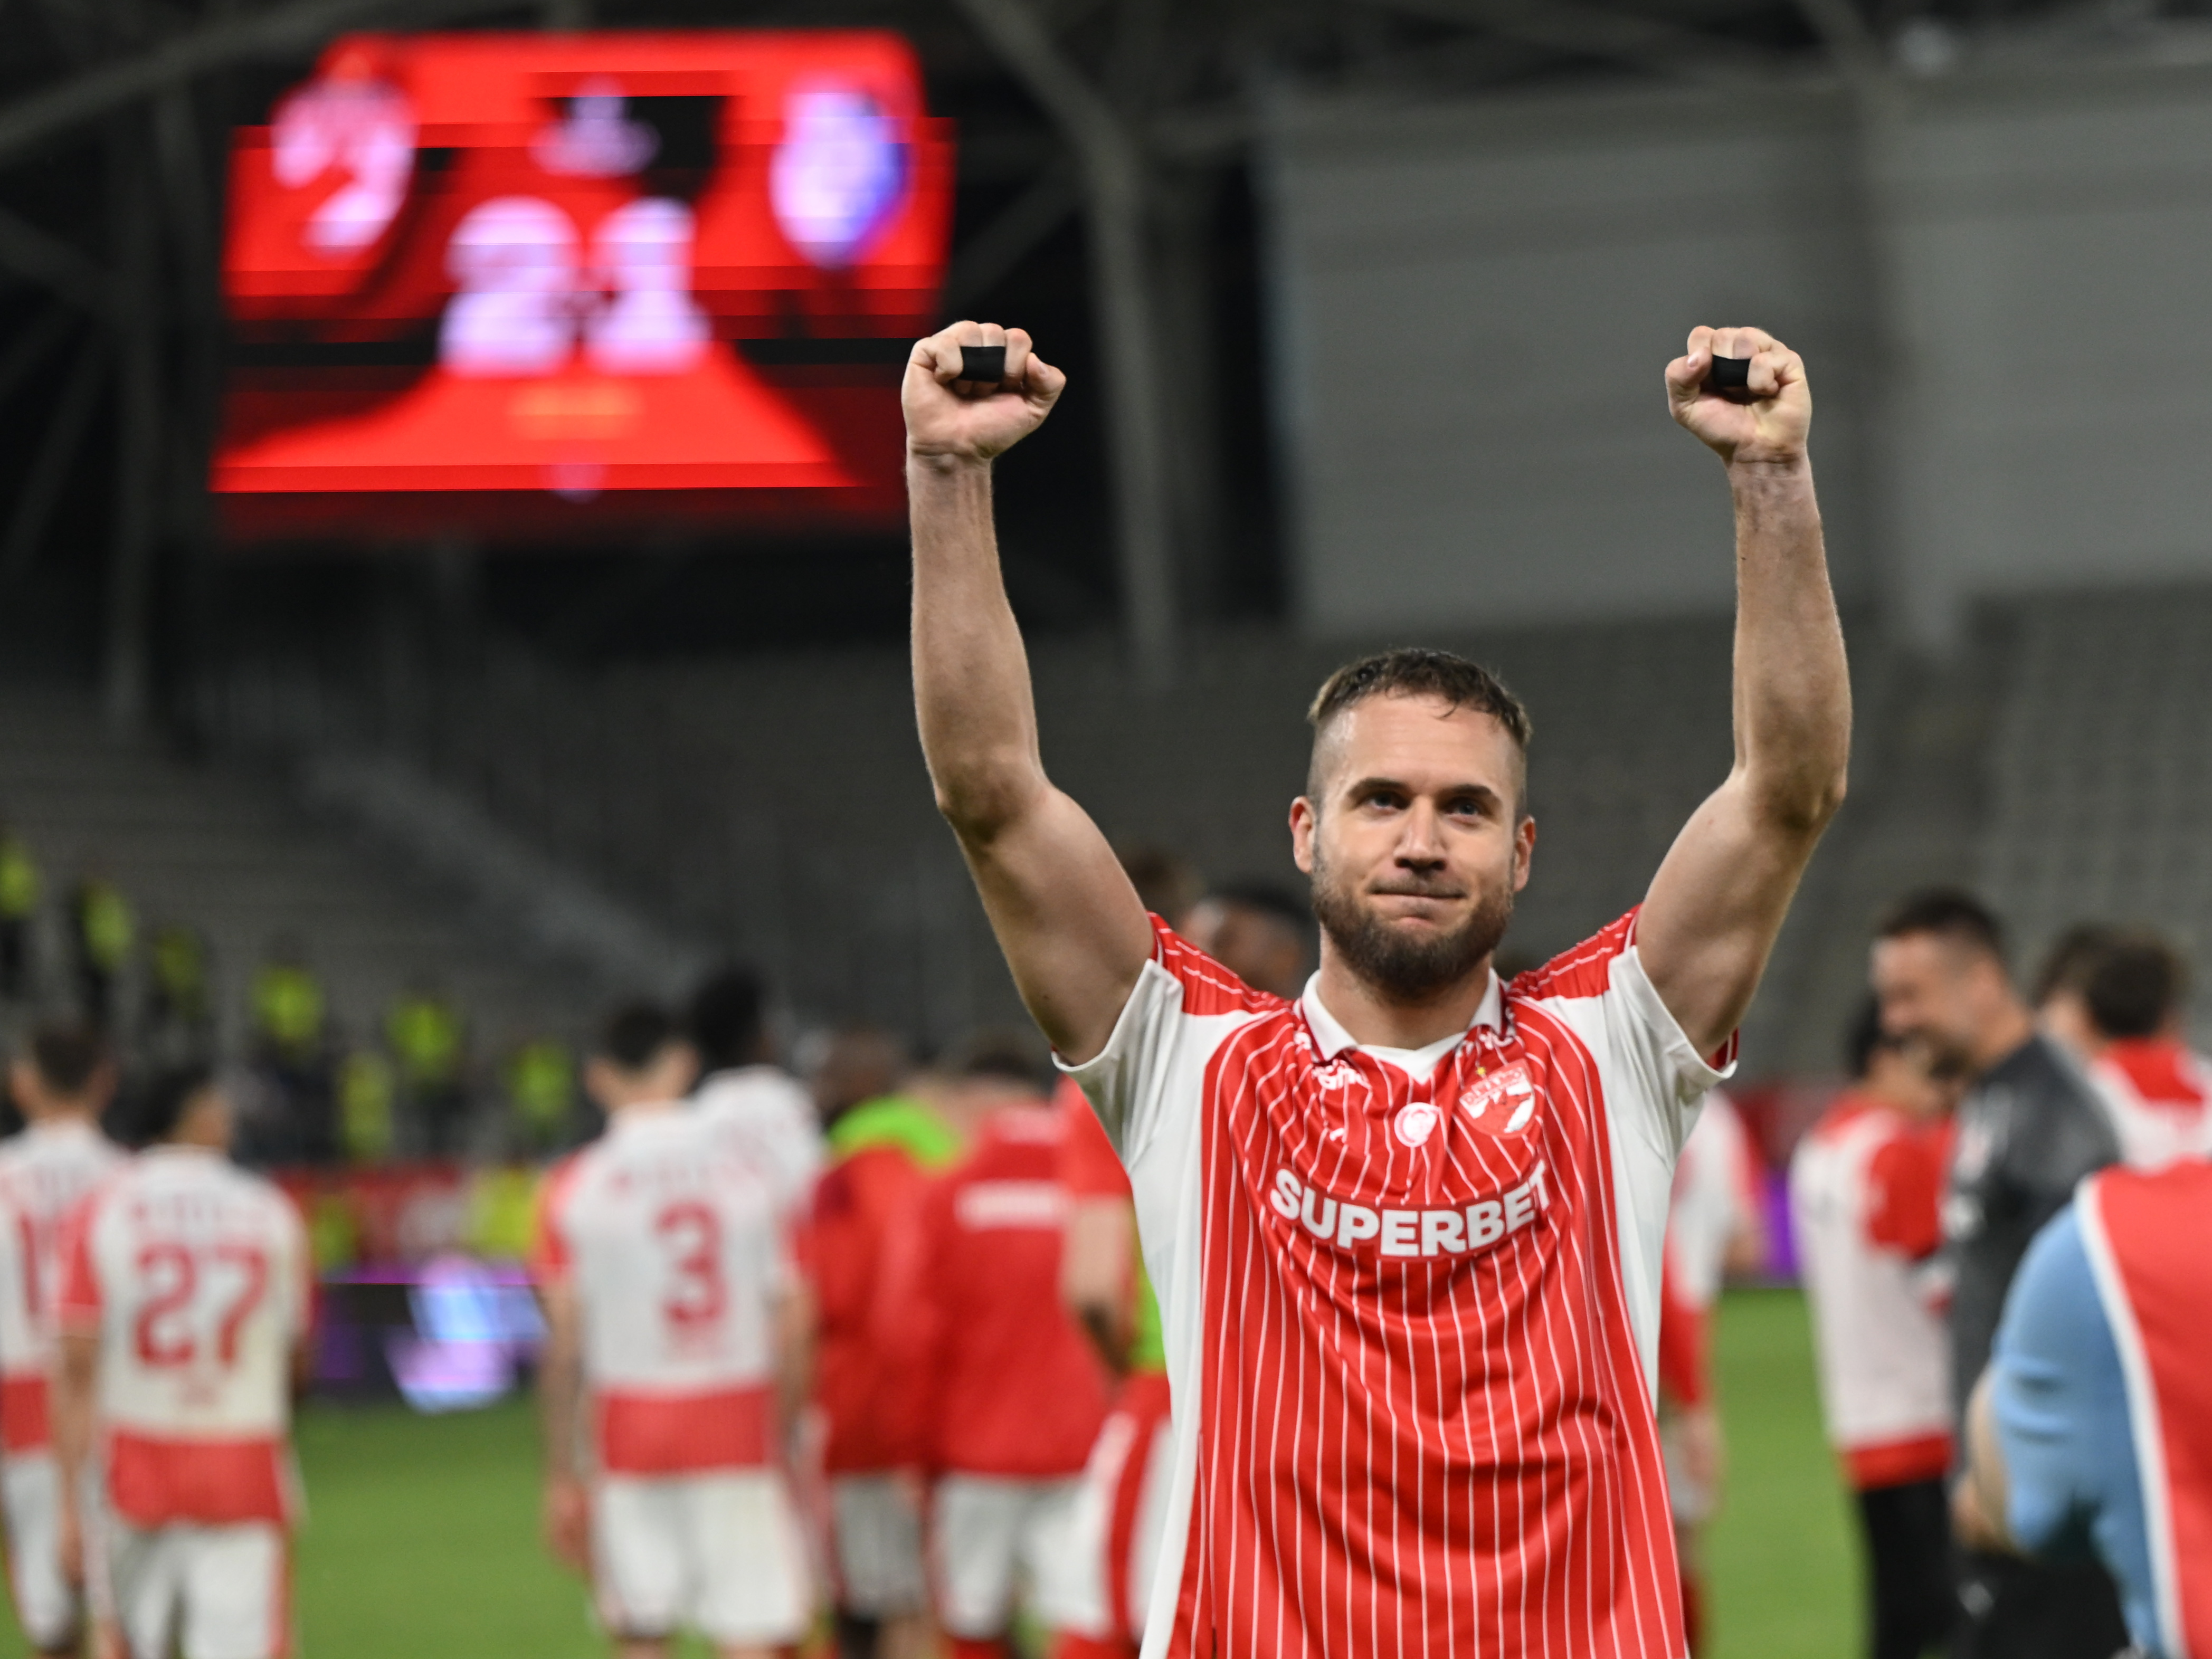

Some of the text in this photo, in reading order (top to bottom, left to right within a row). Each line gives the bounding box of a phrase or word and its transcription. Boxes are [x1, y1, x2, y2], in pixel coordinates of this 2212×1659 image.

[653, 1198, 729, 1324] 3
[1270, 1159, 1550, 1257] SUPERBET
[134, 1237, 267, 1369] 27
